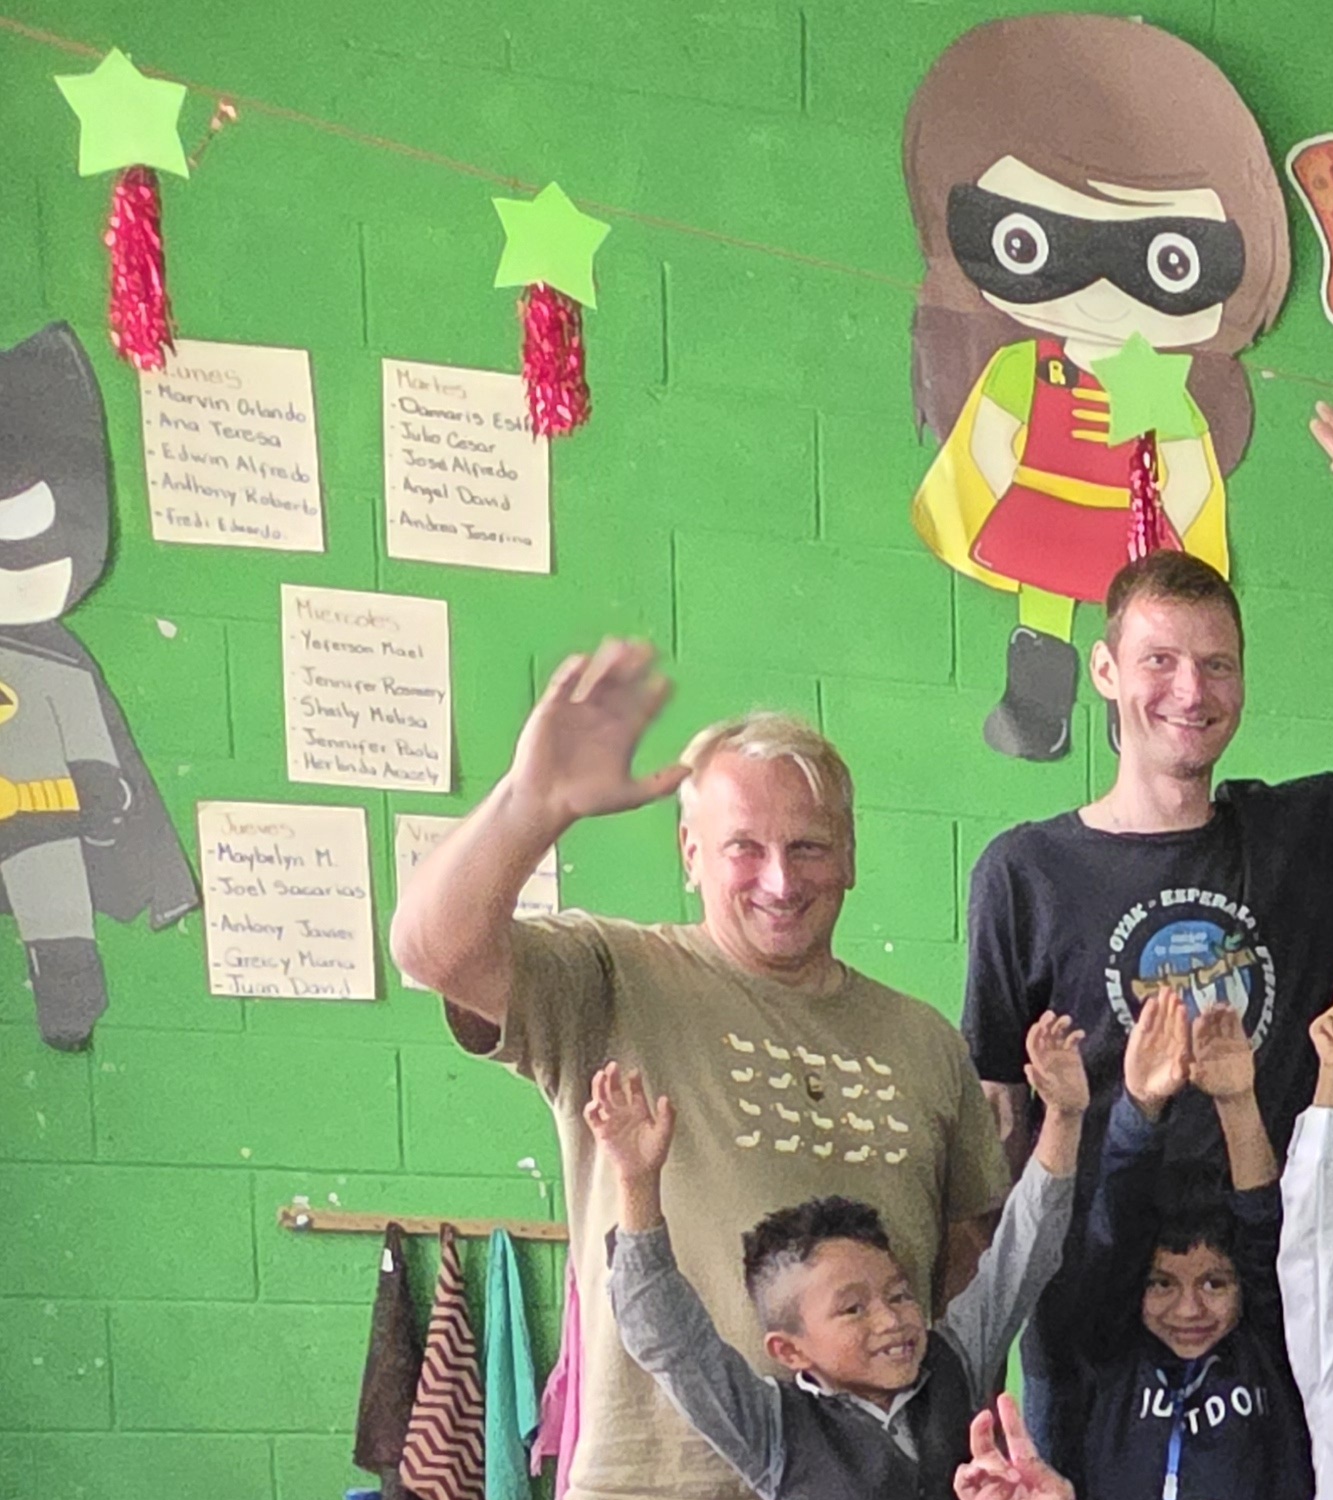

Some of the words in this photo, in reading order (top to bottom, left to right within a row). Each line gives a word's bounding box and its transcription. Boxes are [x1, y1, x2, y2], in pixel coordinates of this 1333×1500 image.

[158, 383, 230, 412] Marvin
[237, 398, 306, 423] Orlando
[399, 396, 484, 425] Damaris
[159, 412, 200, 432] Ana
[209, 420, 282, 448] Teresa
[400, 421, 441, 445] Julio
[161, 442, 229, 469] Edwin
[236, 455, 310, 483] Alfredo
[452, 456, 519, 481] Alfredo
[162, 472, 237, 506] Anthony
[245, 487, 318, 516] Roberto
[403, 476, 448, 504] Angel
[456, 485, 511, 511] David
[302, 666, 377, 695] Jennifer
[303, 727, 386, 756] Jennifer
[217, 842, 305, 872] Maybelyn
[218, 877, 267, 896] Joel
[221, 913, 285, 941] Antony
[226, 973, 280, 995] Juan
